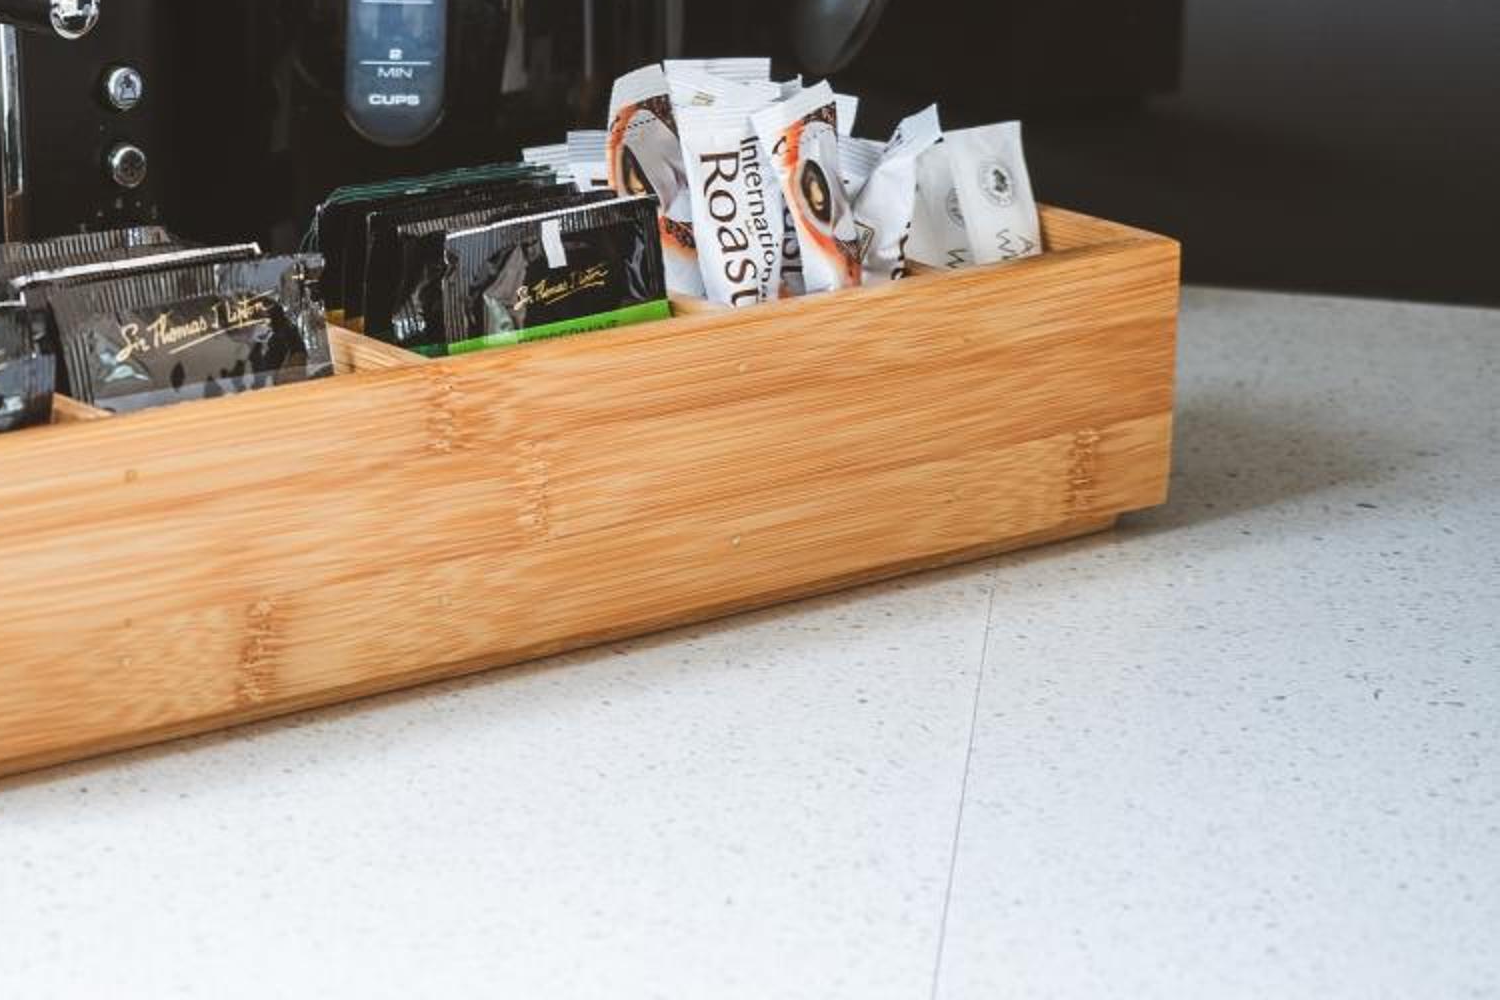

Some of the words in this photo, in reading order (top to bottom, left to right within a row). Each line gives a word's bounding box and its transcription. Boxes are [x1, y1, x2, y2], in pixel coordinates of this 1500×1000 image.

[377, 67, 414, 79] MIN
[368, 94, 420, 106] CUPS
[700, 151, 761, 308] Roast
[115, 322, 151, 362] Sir
[147, 310, 208, 349] Thomas
